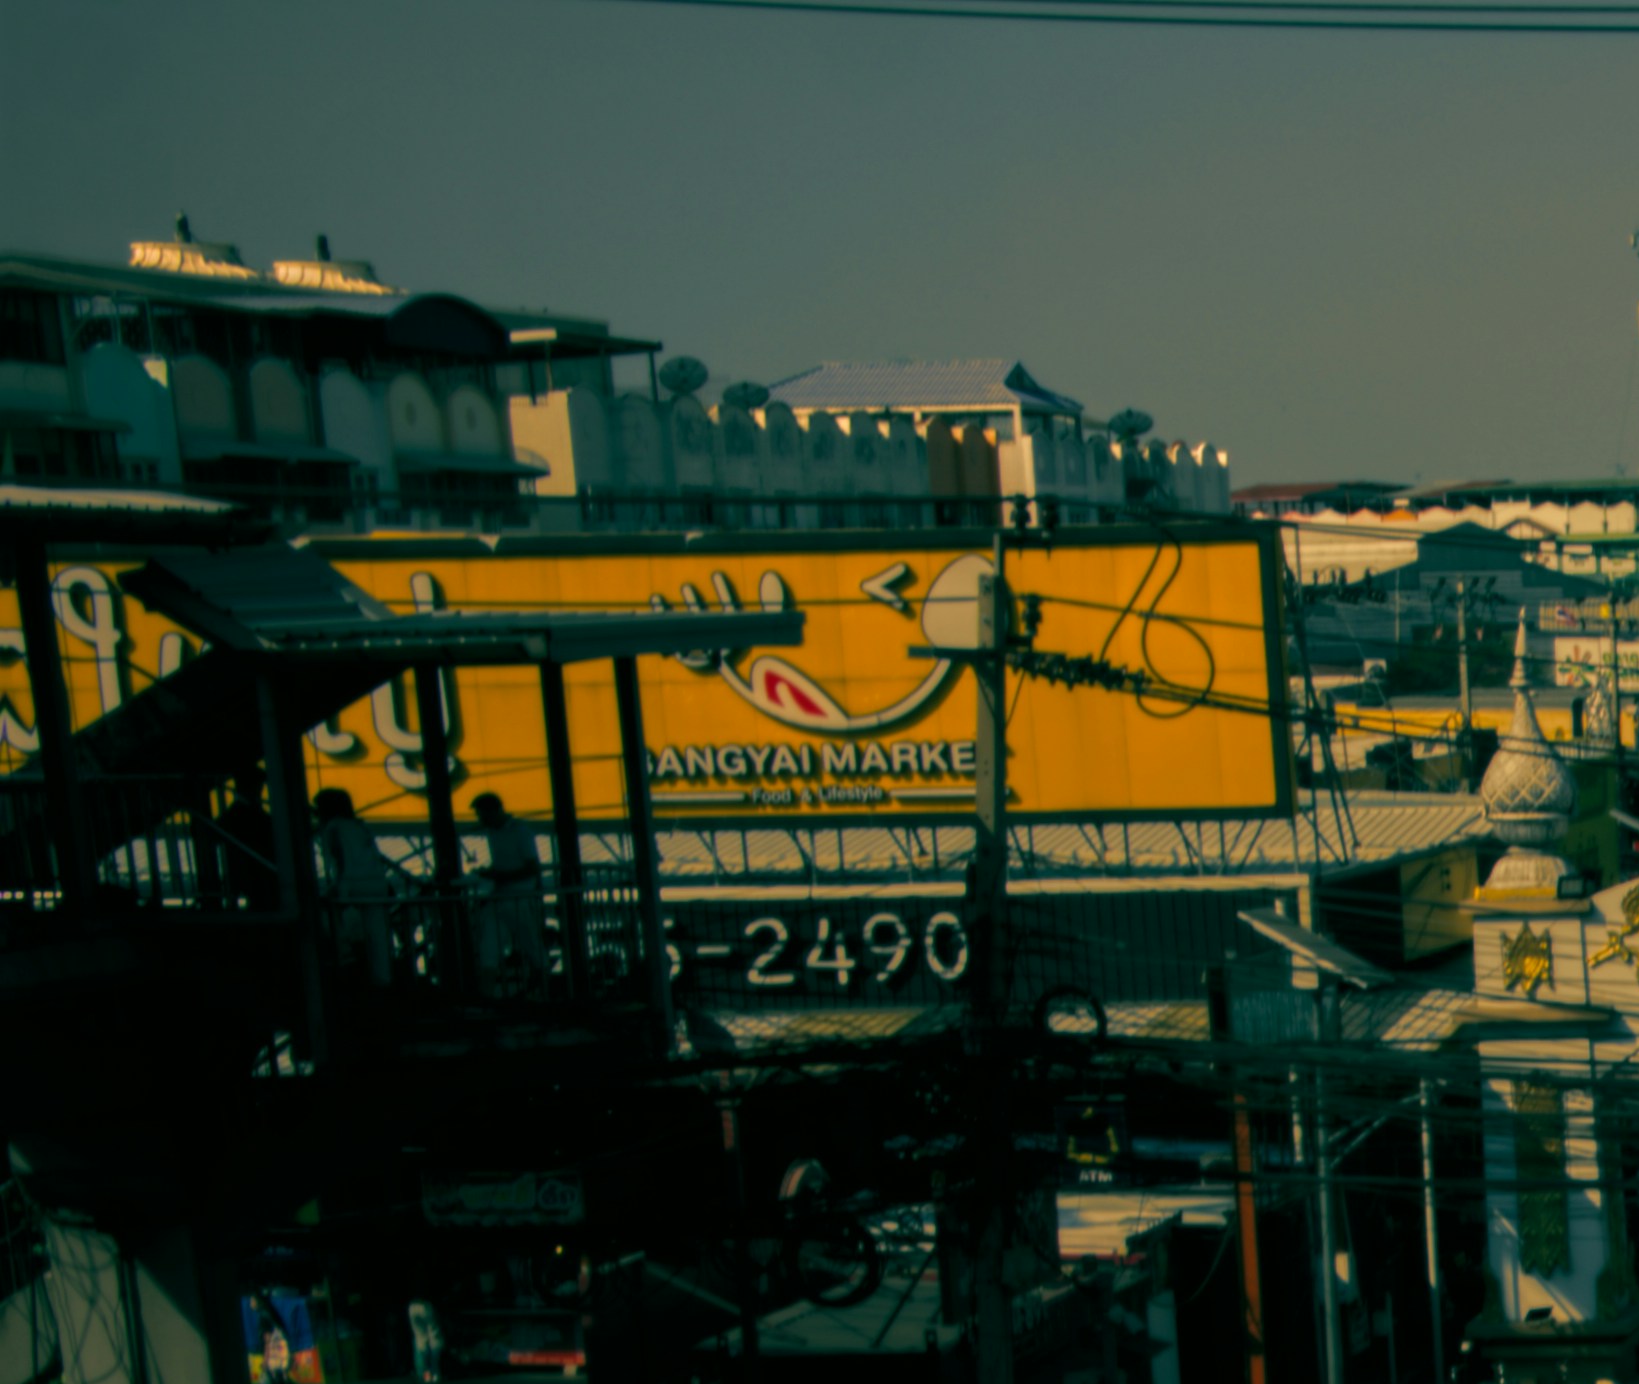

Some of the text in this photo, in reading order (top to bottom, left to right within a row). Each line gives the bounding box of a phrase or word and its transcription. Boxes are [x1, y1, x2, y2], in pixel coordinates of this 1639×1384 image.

[648, 740, 977, 776] ANGYAI MARKE
[751, 785, 883, 804] Food & Lifestyle
